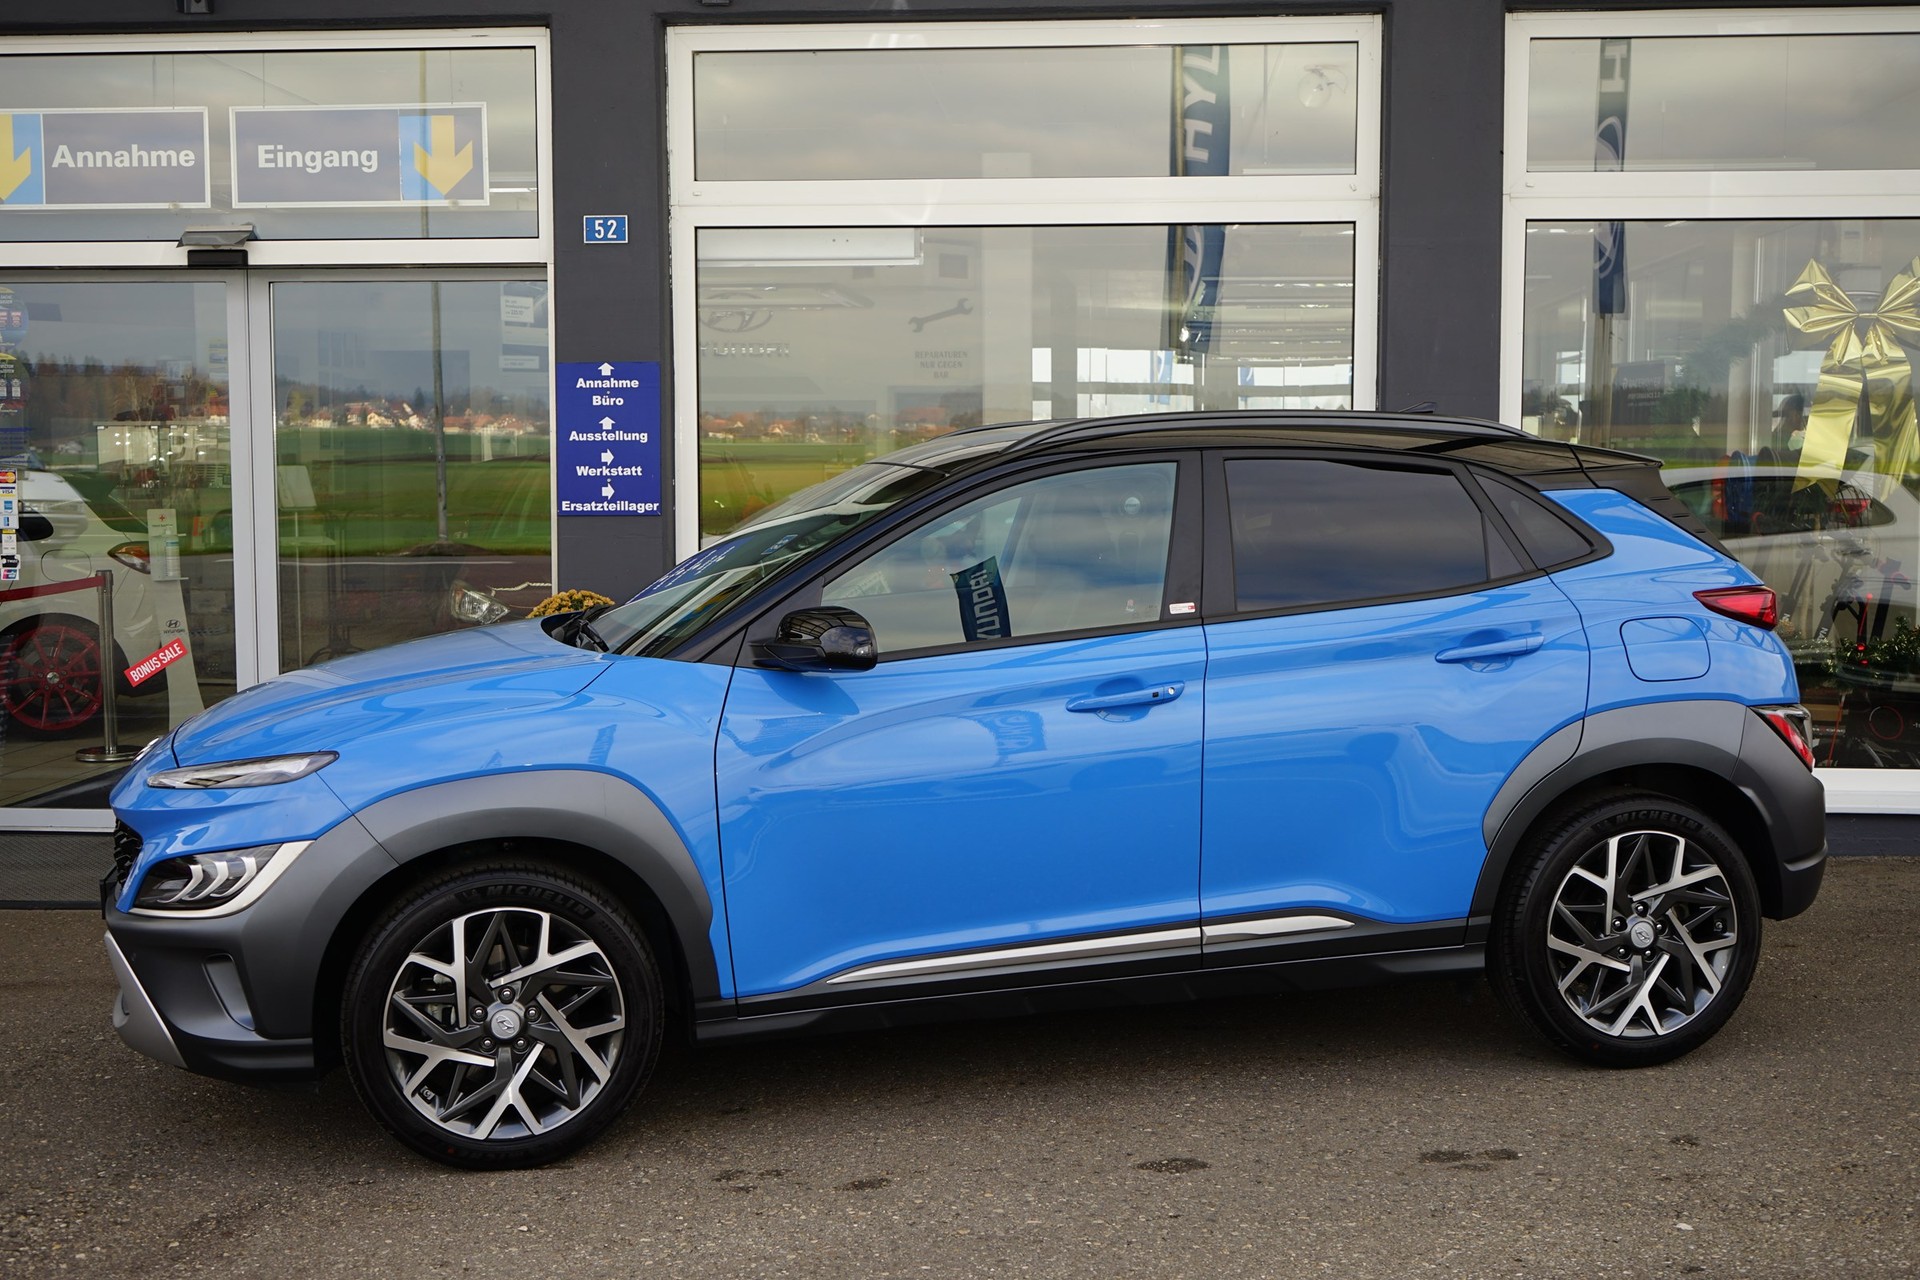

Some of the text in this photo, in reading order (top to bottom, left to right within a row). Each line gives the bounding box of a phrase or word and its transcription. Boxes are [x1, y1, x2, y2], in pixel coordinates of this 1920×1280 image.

[52, 144, 196, 169] Annahme
[257, 144, 379, 174] Eingang
[593, 219, 618, 239] 52
[914, 351, 968, 359] REPARATUREN
[576, 377, 640, 389] Annahme
[592, 395, 624, 406] Büro
[569, 430, 648, 443] Ausstellung
[576, 465, 643, 477] Werkstatt
[561, 500, 660, 513] Ersatzteillager
[129, 642, 184, 683] BONUS SALE
[1615, 810, 1699, 830] MICHELIN
[487, 885, 591, 914] MICHELIN
